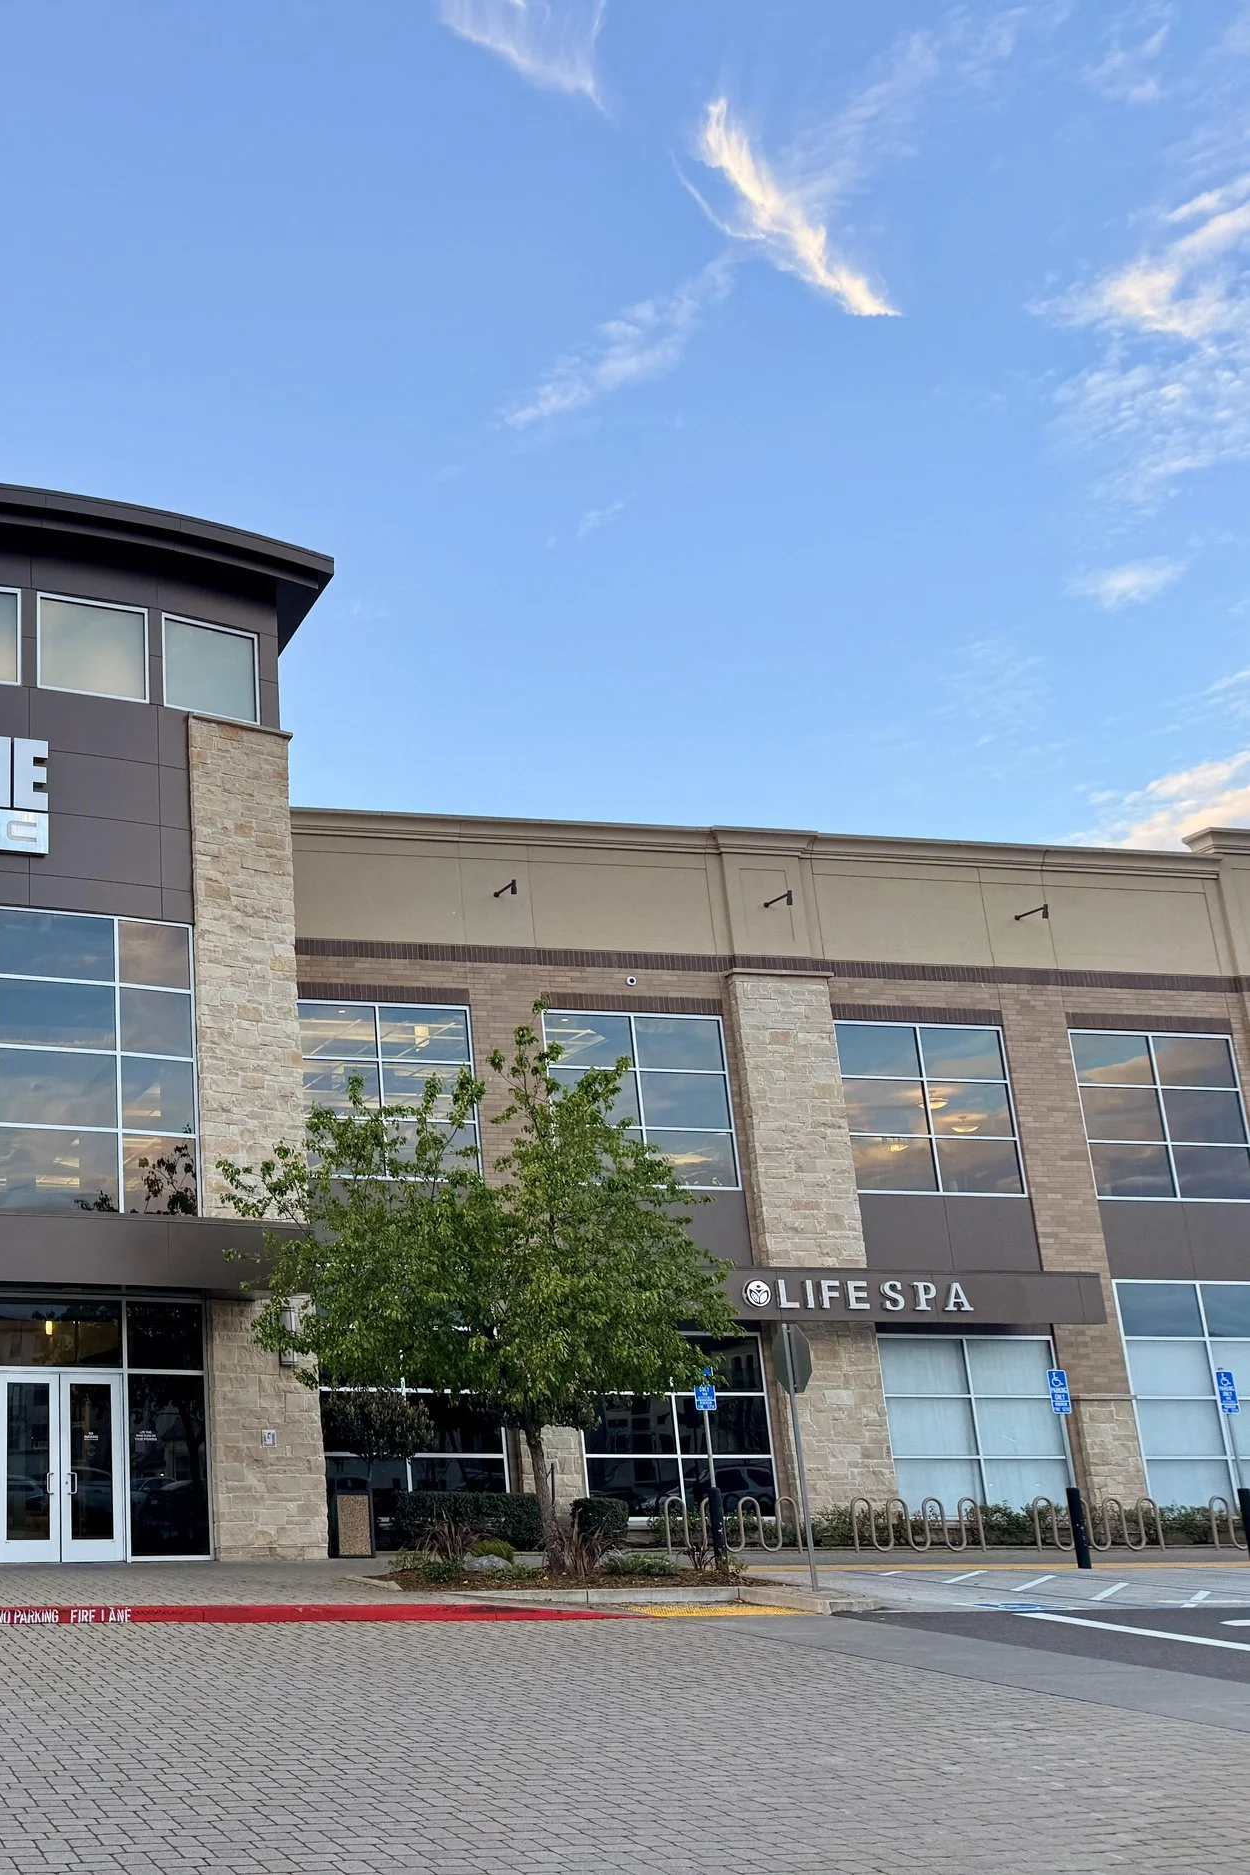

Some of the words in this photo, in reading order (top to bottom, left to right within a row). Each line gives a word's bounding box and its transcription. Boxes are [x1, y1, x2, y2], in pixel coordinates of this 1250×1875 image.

[775, 1279, 871, 1310] LIFE
[879, 1280, 975, 1311] SPA
[13, 1609, 59, 1624] PARKING
